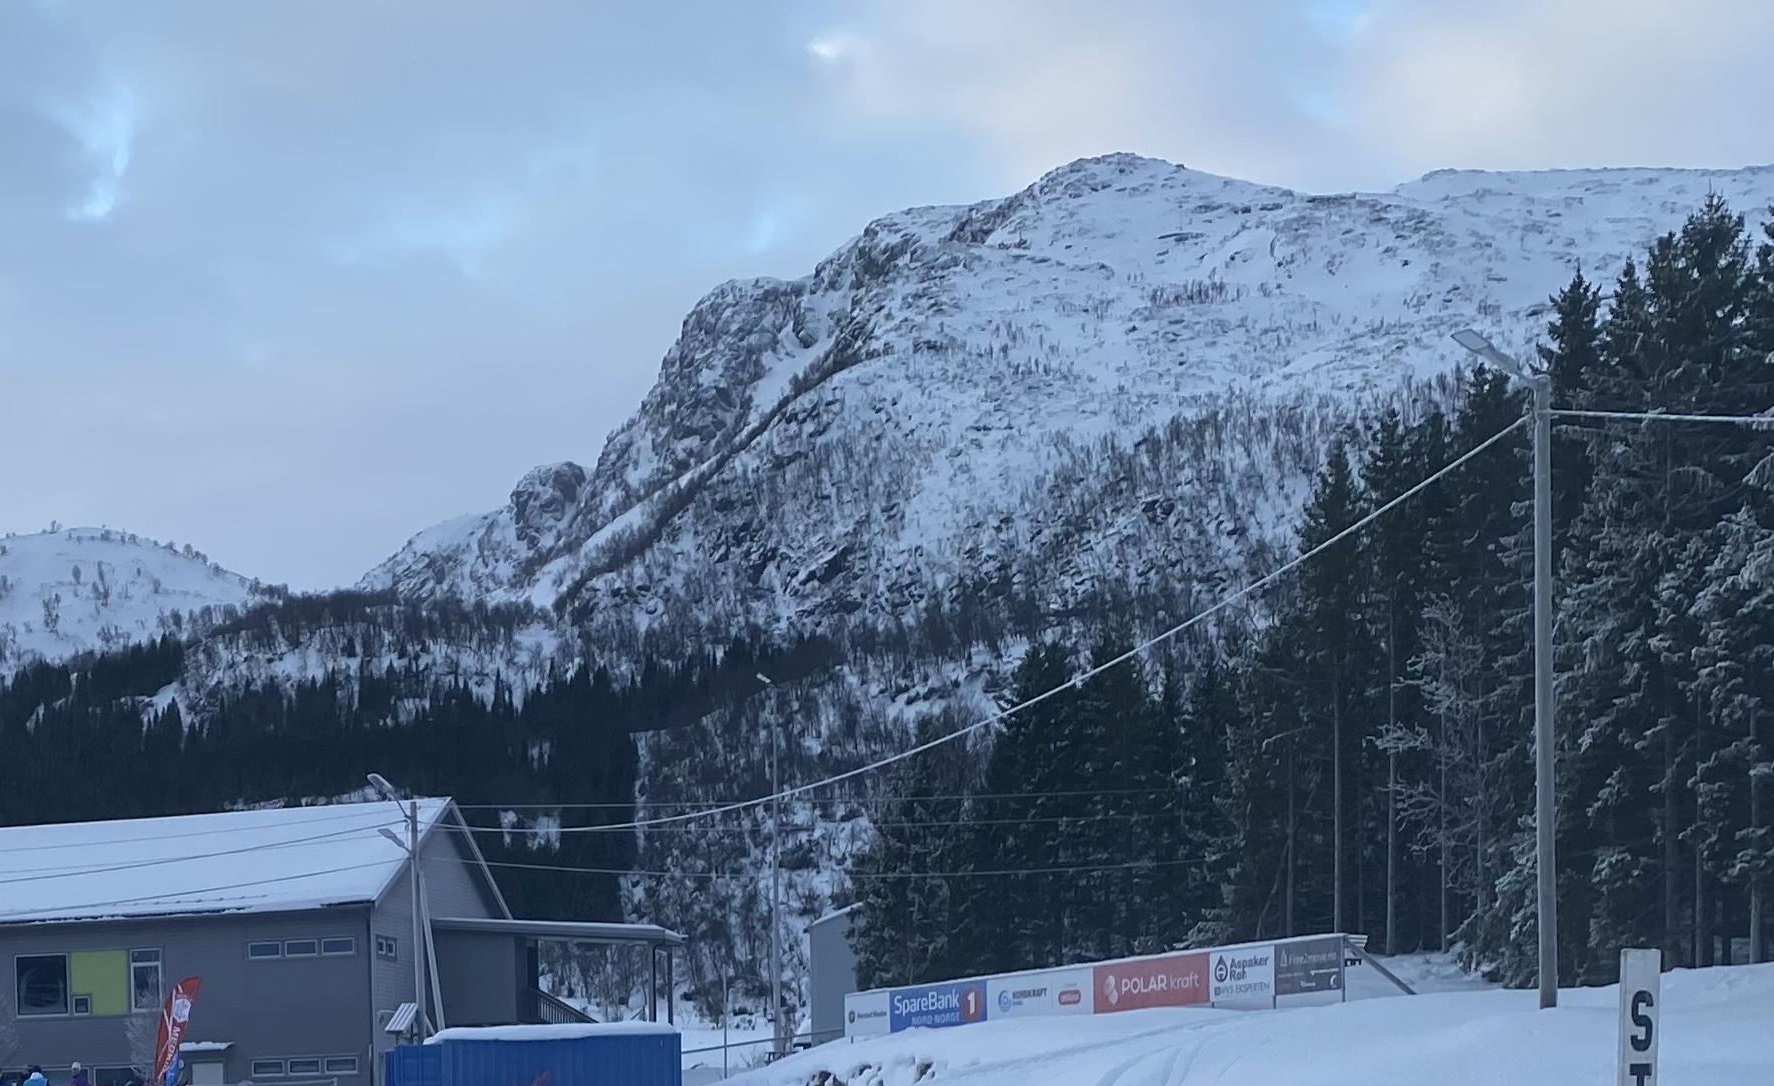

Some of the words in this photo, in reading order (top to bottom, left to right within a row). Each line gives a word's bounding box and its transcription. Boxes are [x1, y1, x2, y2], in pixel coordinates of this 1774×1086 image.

[1121, 974, 1168, 995] POLAR
[1169, 971, 1200, 989] kraft
[893, 989, 960, 1016] SpareBank
[967, 991, 976, 1015] 1
